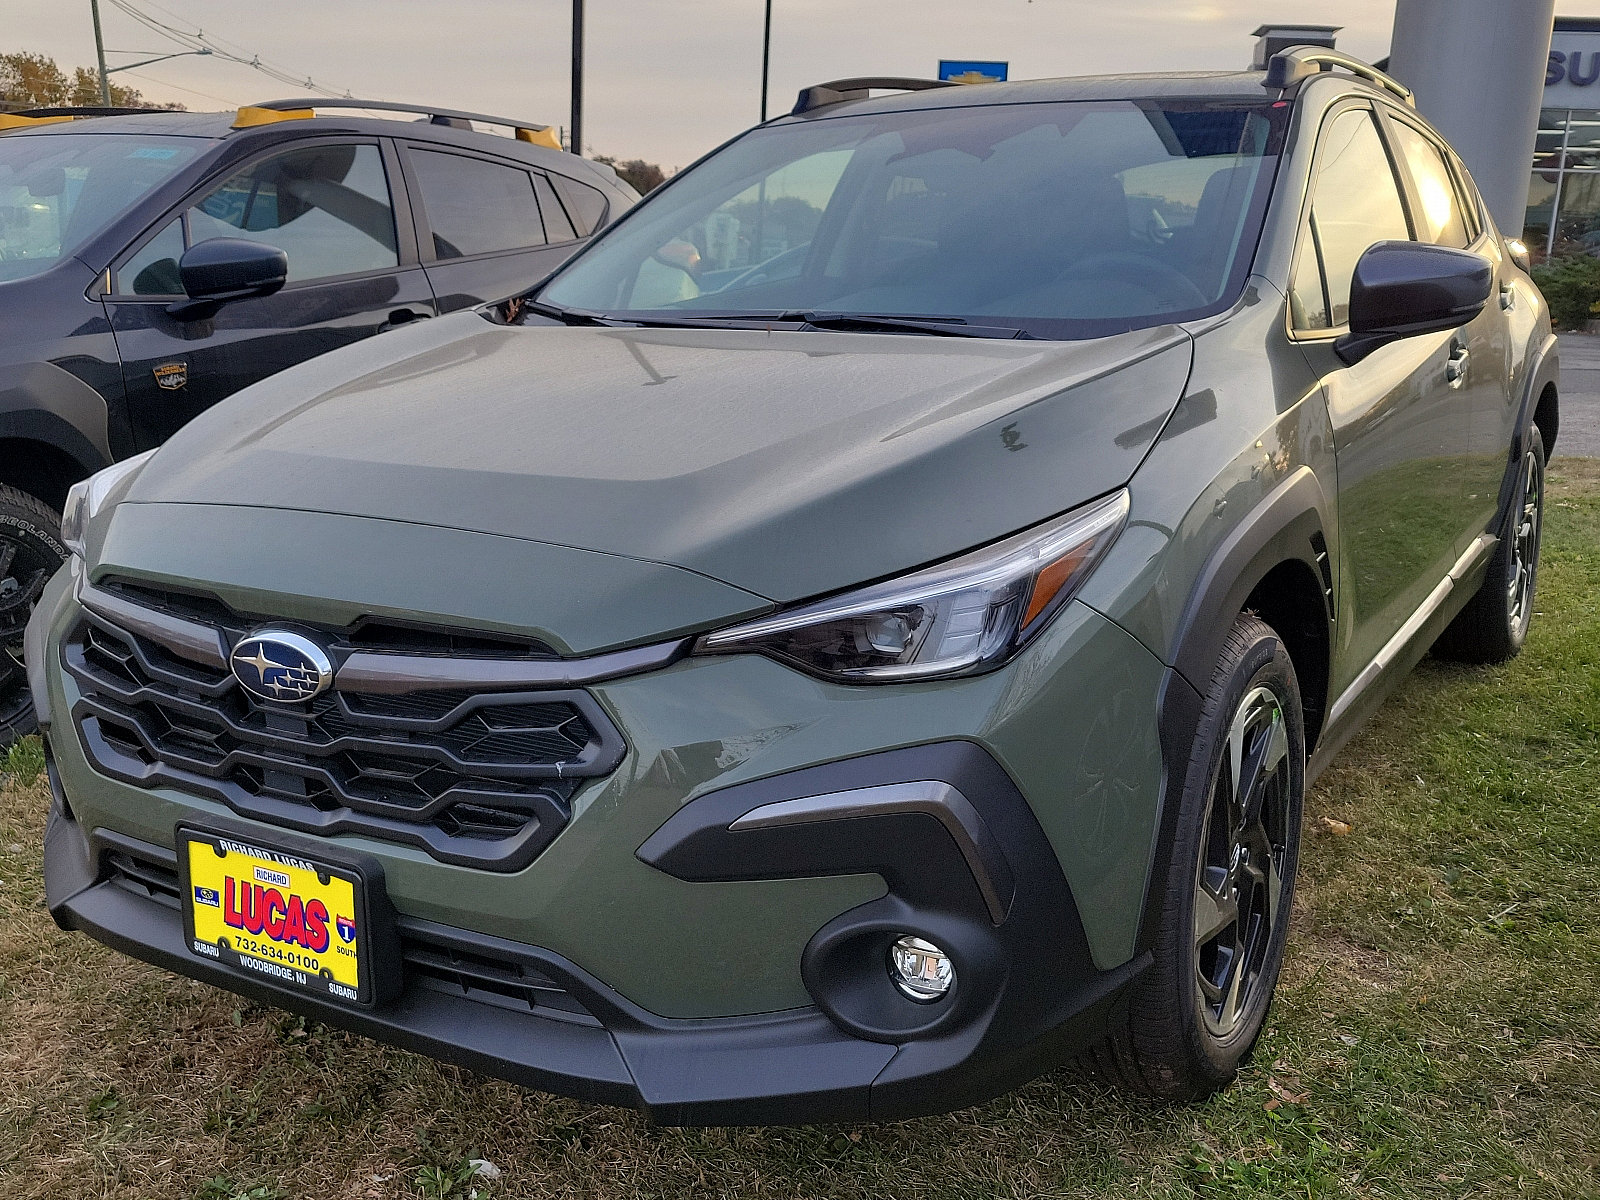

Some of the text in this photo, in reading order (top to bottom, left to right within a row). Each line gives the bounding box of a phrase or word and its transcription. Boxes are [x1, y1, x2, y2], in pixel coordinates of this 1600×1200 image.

[219, 839, 315, 872] RICHARD LUCAS
[256, 868, 287, 885] RICHARD
[195, 896, 219, 907] SUBARU
[224, 875, 330, 953] LUCAS
[342, 926, 351, 941] 1
[193, 940, 219, 958] SUBARU
[235, 936, 319, 970] 732-634-0100
[240, 954, 307, 985] WOODBRIDGE, NJ
[329, 982, 357, 1001] SUBARU
